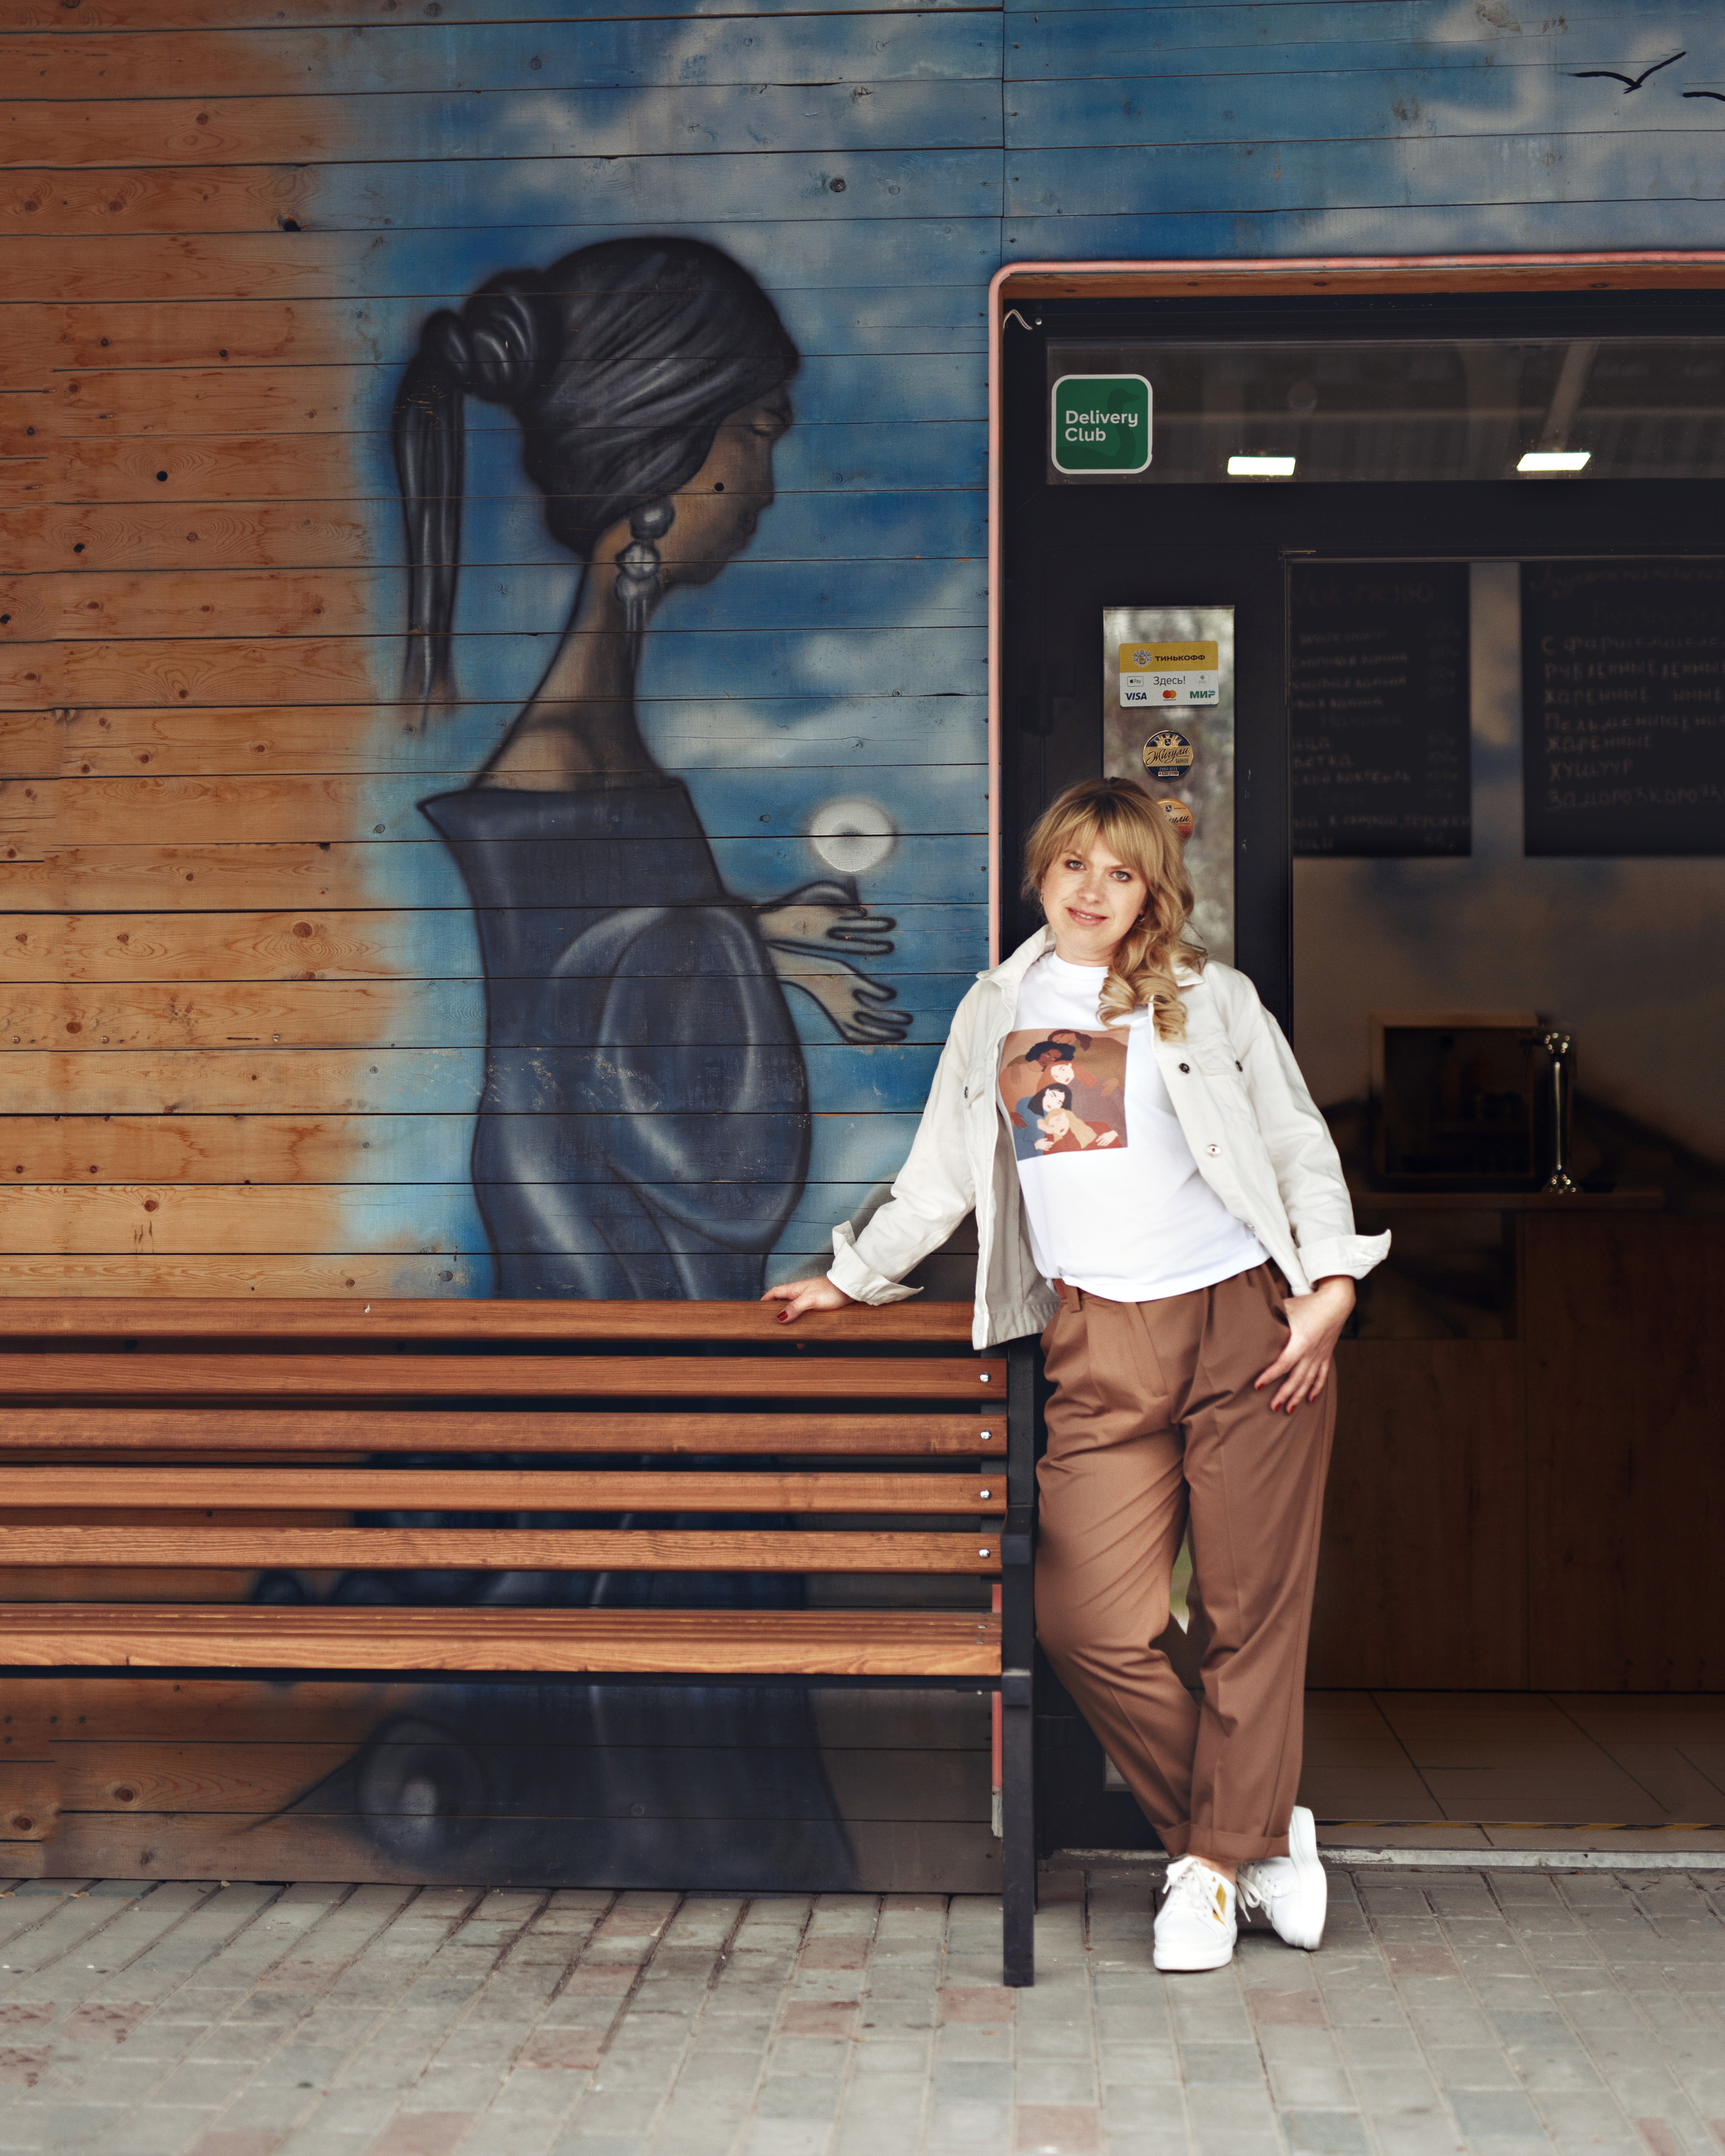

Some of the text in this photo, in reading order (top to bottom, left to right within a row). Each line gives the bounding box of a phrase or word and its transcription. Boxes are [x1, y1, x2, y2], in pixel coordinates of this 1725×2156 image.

[1065, 410, 1138, 427] Delivery
[1065, 427, 1106, 442] Club
[1153, 676, 1186, 686] Здесь!
[1125, 692, 1147, 700] VISA
[1190, 690, 1216, 699] МИР
[1146, 747, 1190, 766] Жигули
